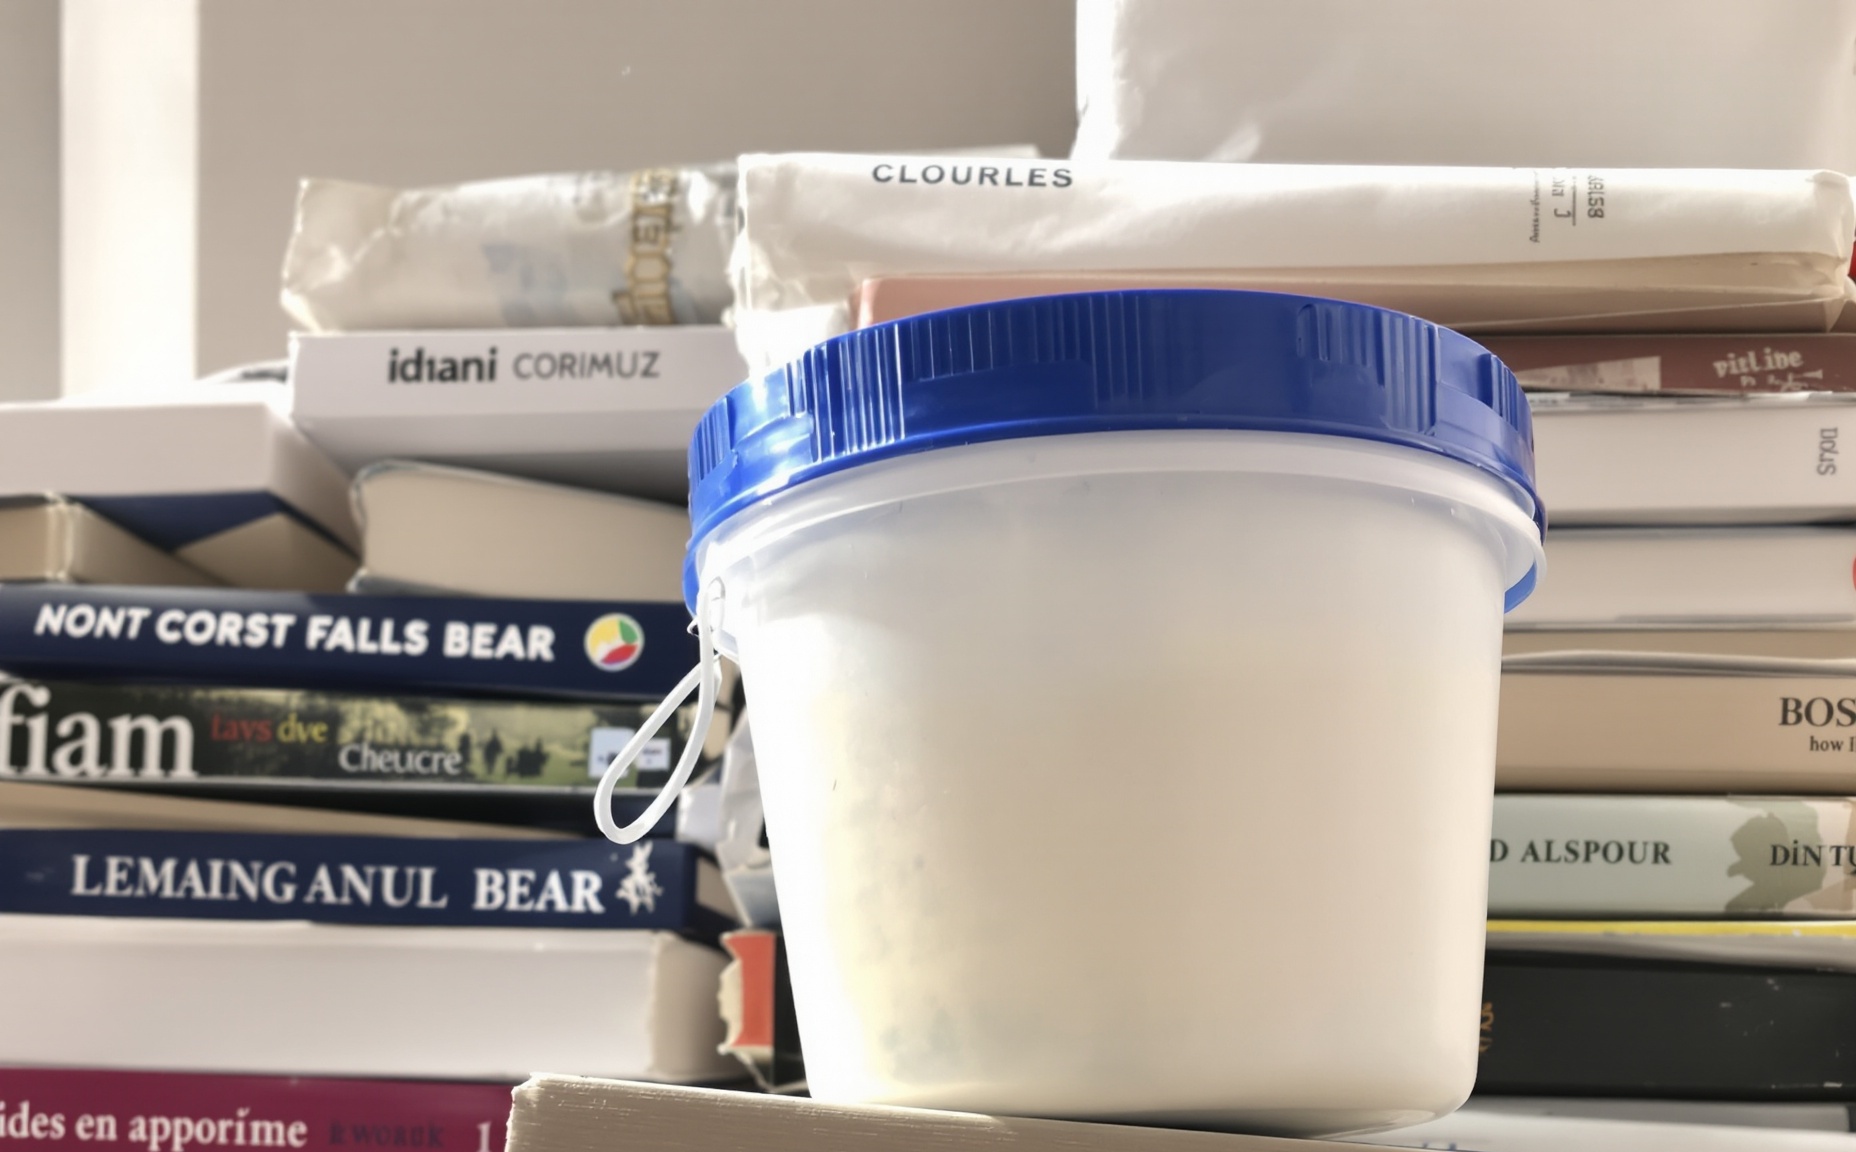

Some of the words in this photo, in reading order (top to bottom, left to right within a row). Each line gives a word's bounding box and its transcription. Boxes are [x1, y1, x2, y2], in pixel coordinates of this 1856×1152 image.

[872, 164, 1073, 188] CLOURLES
[512, 352, 661, 379] CORIMUZ
[35, 605, 149, 638] NONT
[156, 610, 295, 648] CORST
[306, 616, 428, 655] FALLS
[443, 622, 555, 661] BEAR
[1809, 736, 1843, 751] how
[1520, 839, 1672, 864] ALSPOUR
[72, 856, 297, 902] LEMAING
[473, 870, 605, 913] BEAR
[75, 1113, 118, 1141] en
